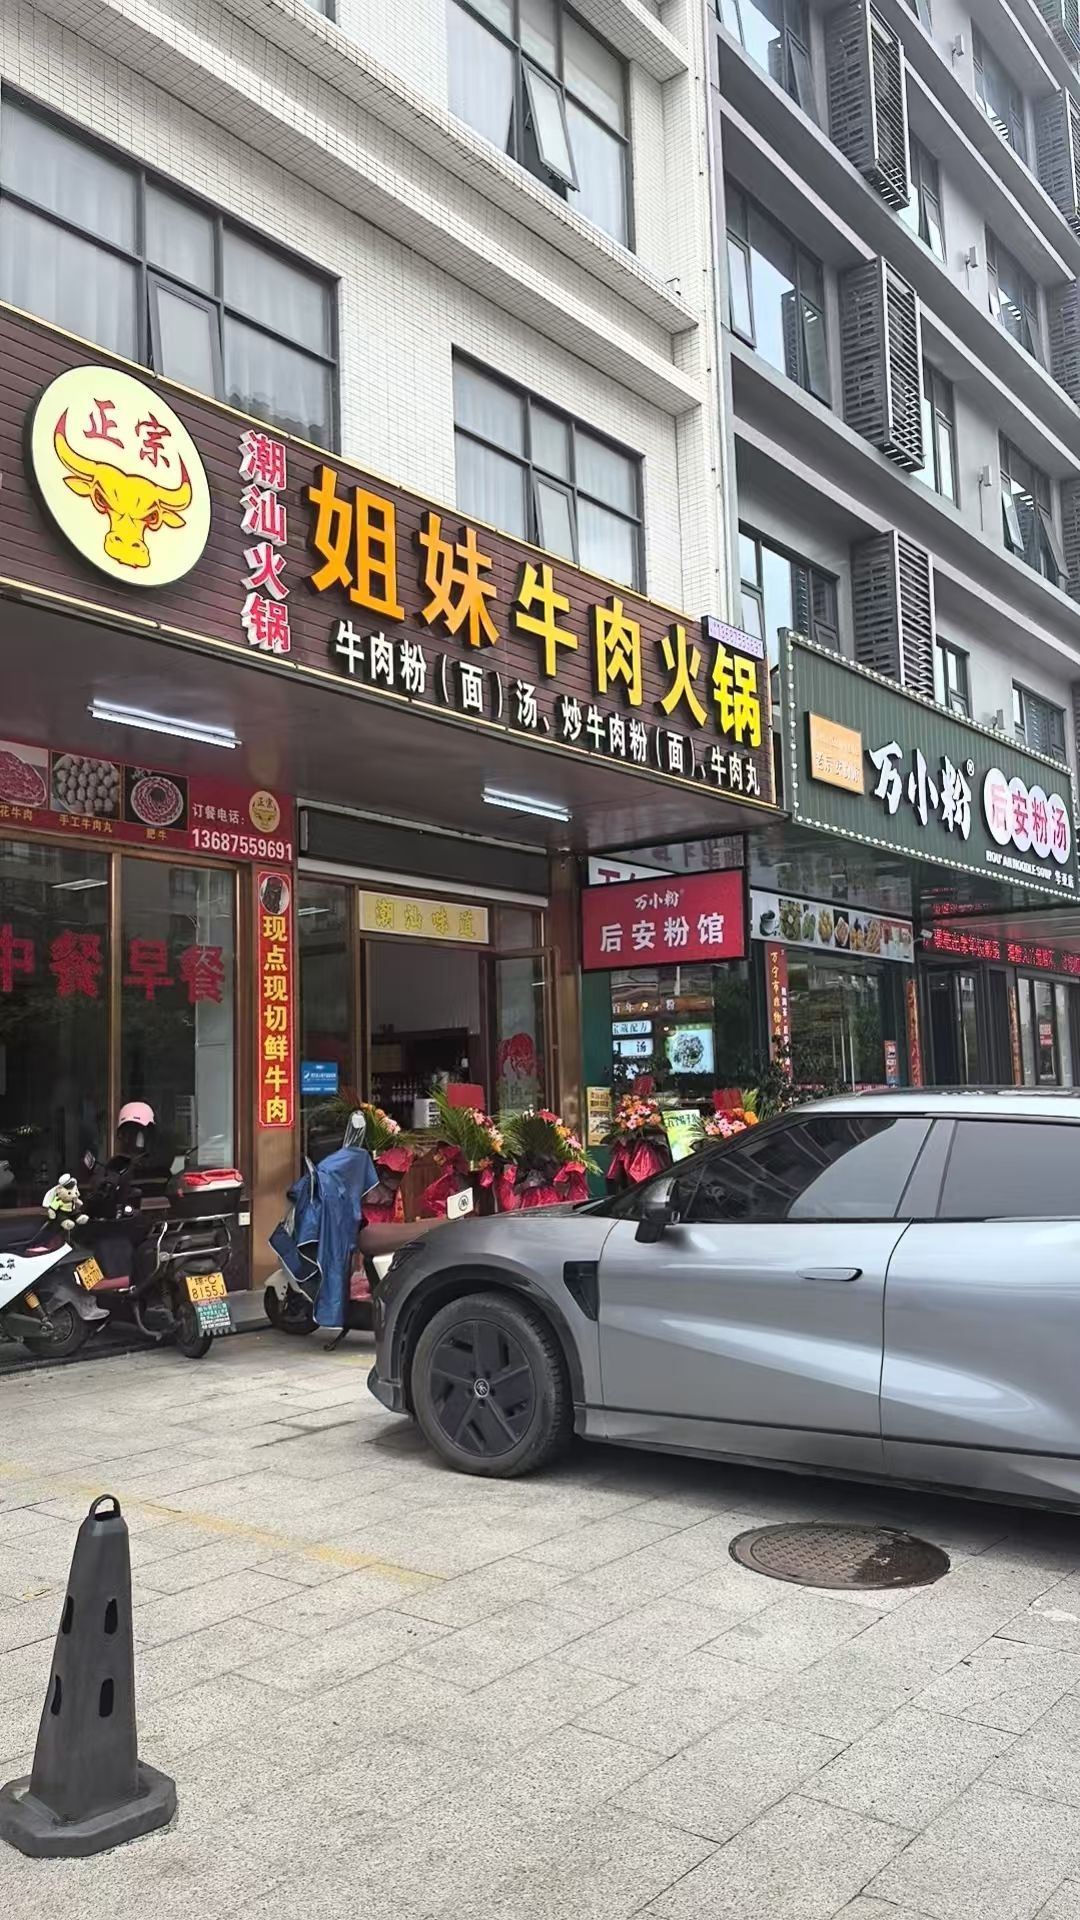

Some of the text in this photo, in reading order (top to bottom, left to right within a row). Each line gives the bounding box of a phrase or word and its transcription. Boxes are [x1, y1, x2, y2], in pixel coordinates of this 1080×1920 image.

[83, 397, 172, 468] 正宗
[240, 429, 291, 653] 潮汕火锅
[308, 465, 762, 749] 姐妹牛肉火锅
[59, 814, 113, 833] 手工牛肉丸
[192, 828, 293, 861] 13687559691
[990, 783, 1067, 852] 后安粉汤
[600, 912, 725, 953] 后安粉馆
[123, 937, 226, 1005] 早餐
[262, 914, 290, 1124] 现点现切鲜牛肉
[191, 1284, 225, 1300] 8155J
